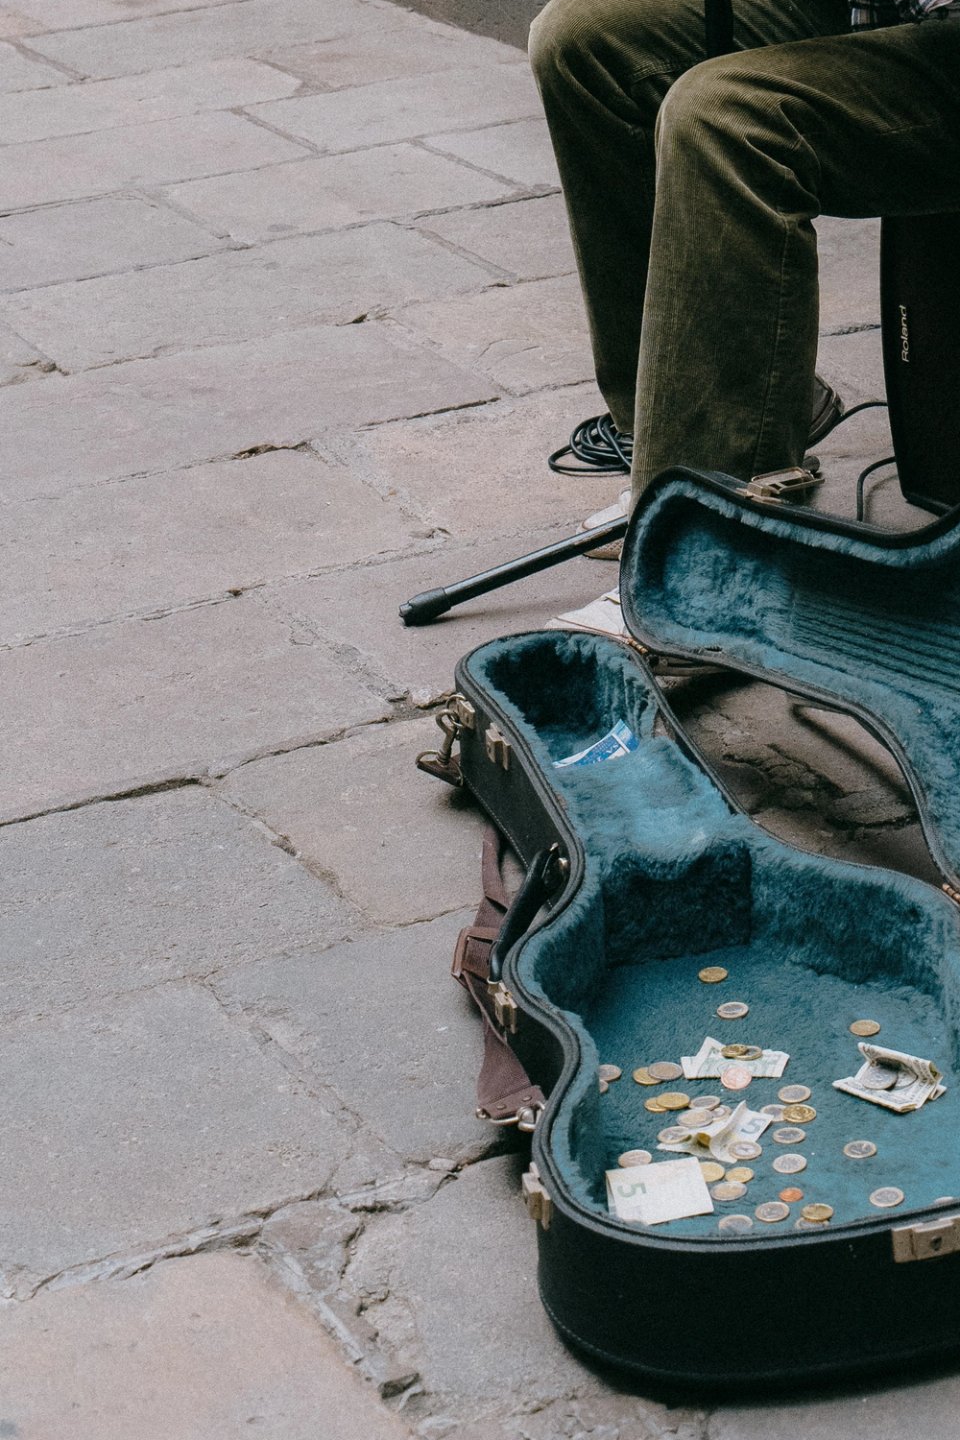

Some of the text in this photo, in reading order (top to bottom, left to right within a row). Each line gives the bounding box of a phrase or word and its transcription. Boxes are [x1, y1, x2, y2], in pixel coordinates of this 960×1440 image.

[899, 304, 910, 363] Roland
[740, 1117, 768, 1135] 5
[617, 1182, 647, 1198] 5
